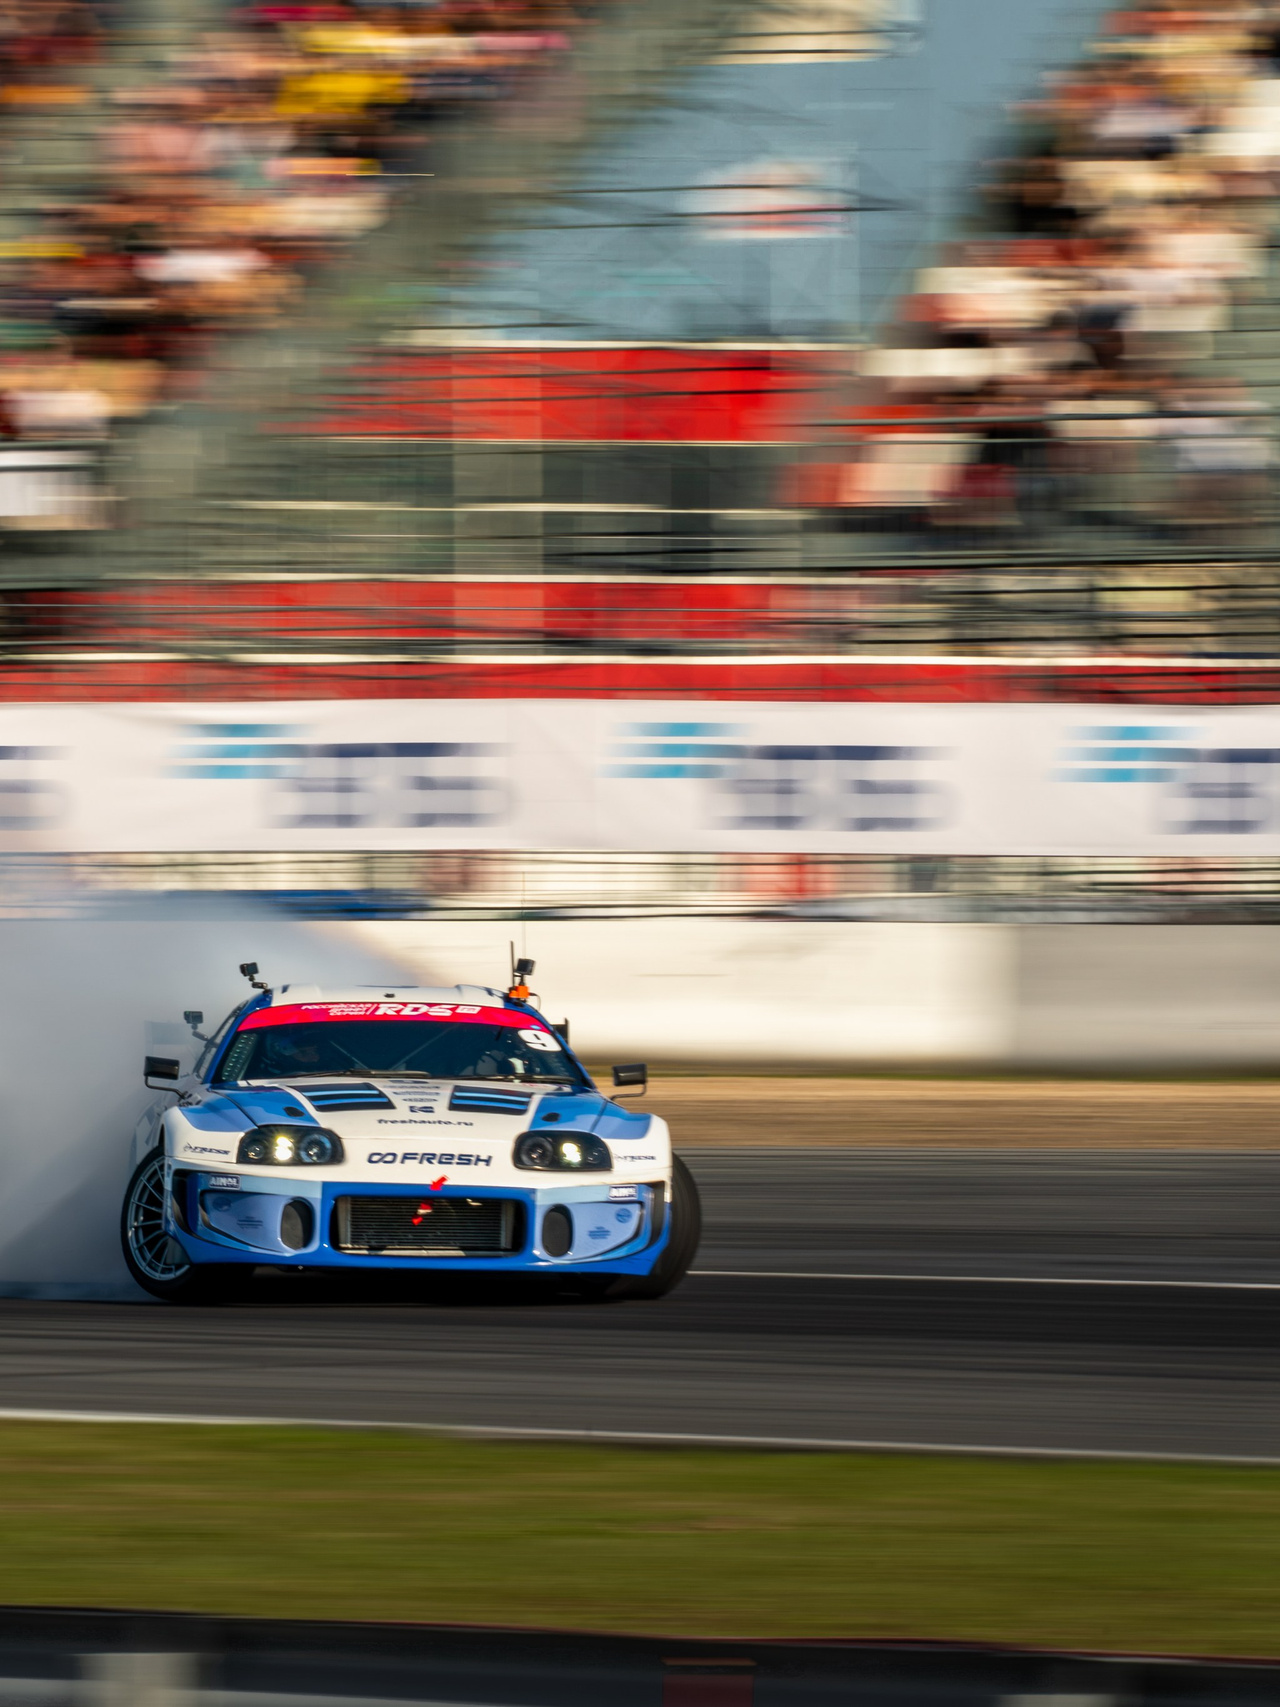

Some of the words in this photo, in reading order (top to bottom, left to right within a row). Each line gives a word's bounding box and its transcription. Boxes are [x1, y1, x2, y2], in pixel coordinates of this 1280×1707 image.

[374, 1003, 457, 1016] RDS
[517, 1029, 562, 1051] 9
[377, 1118, 474, 1126] freshauto.ru
